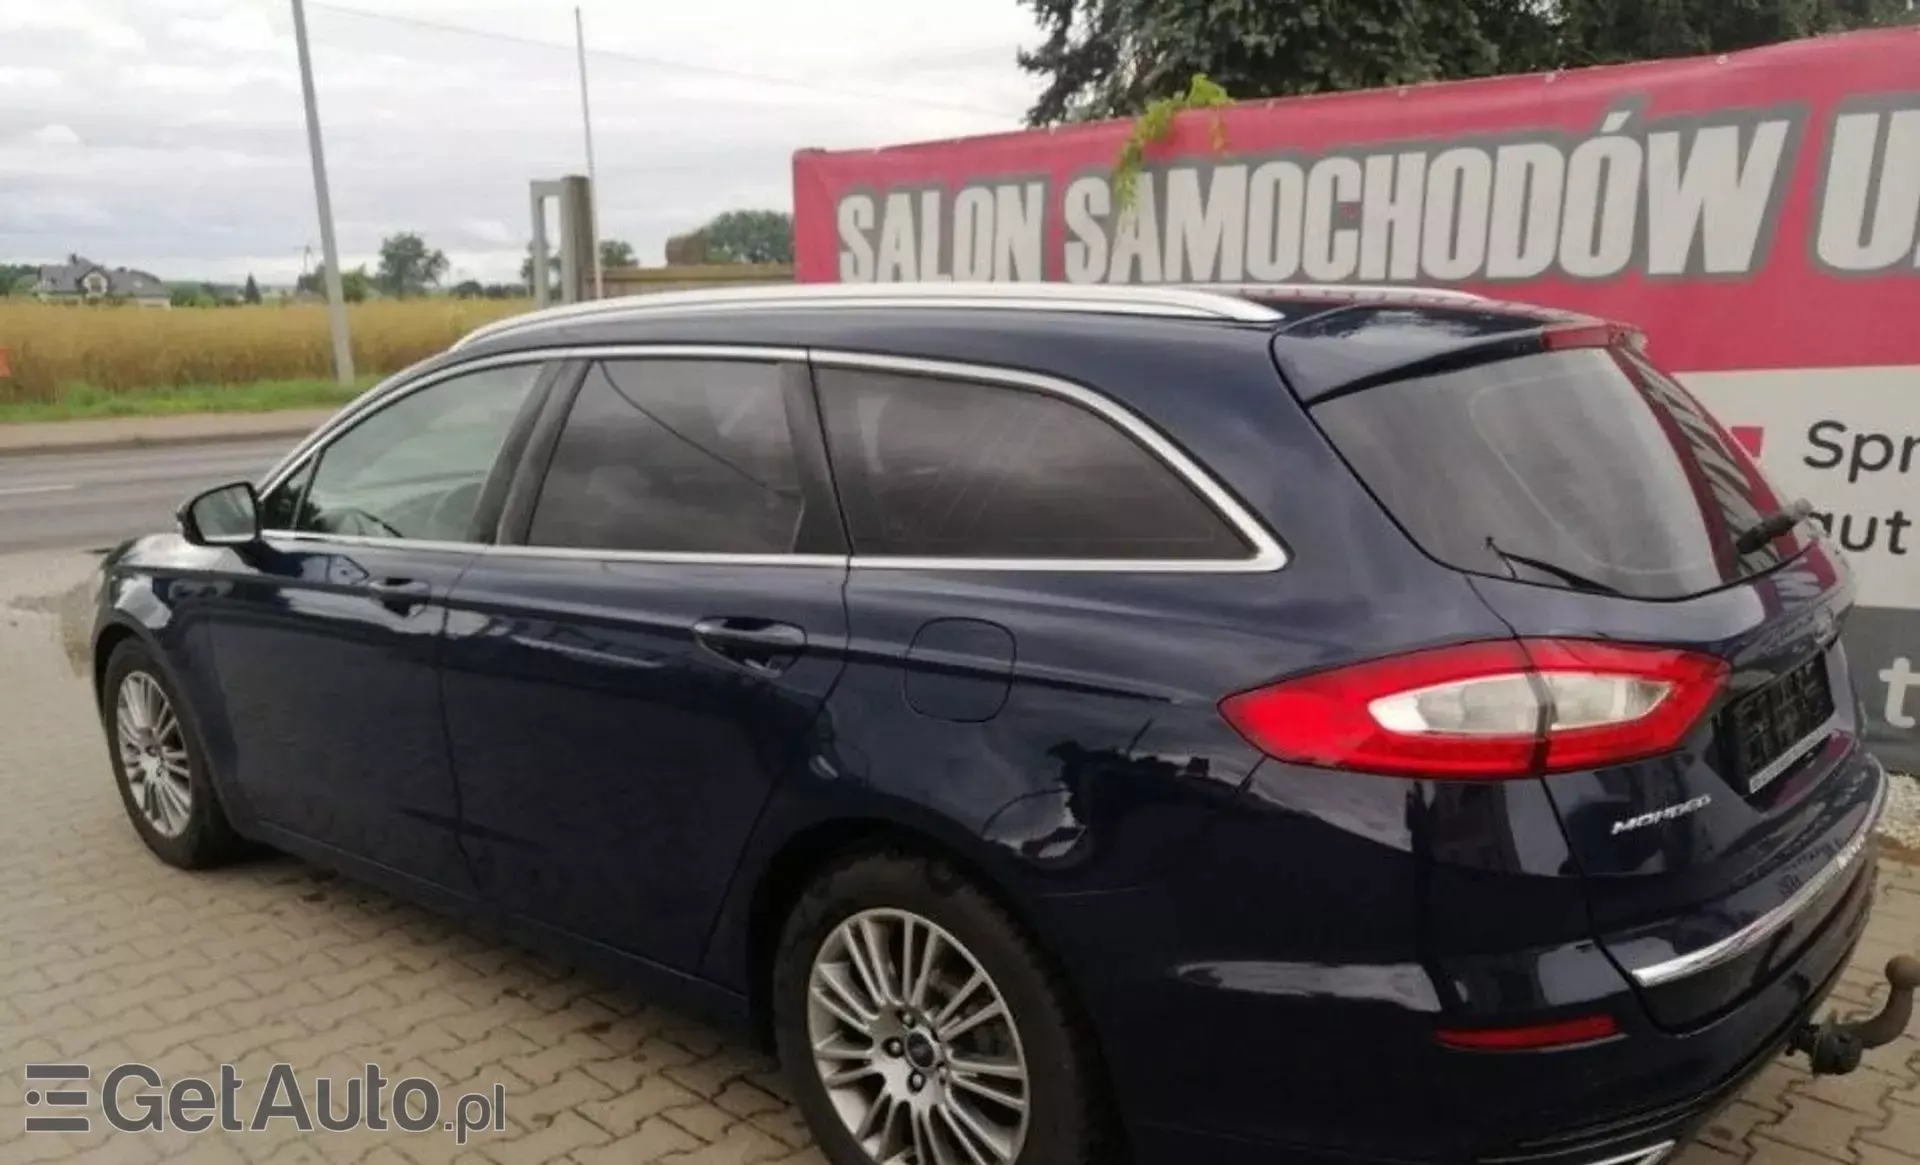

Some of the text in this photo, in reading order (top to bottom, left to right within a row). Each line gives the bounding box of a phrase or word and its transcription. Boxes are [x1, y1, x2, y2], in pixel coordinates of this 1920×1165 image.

[838, 109, 1920, 284] SALON SAMOCHODÓW U
